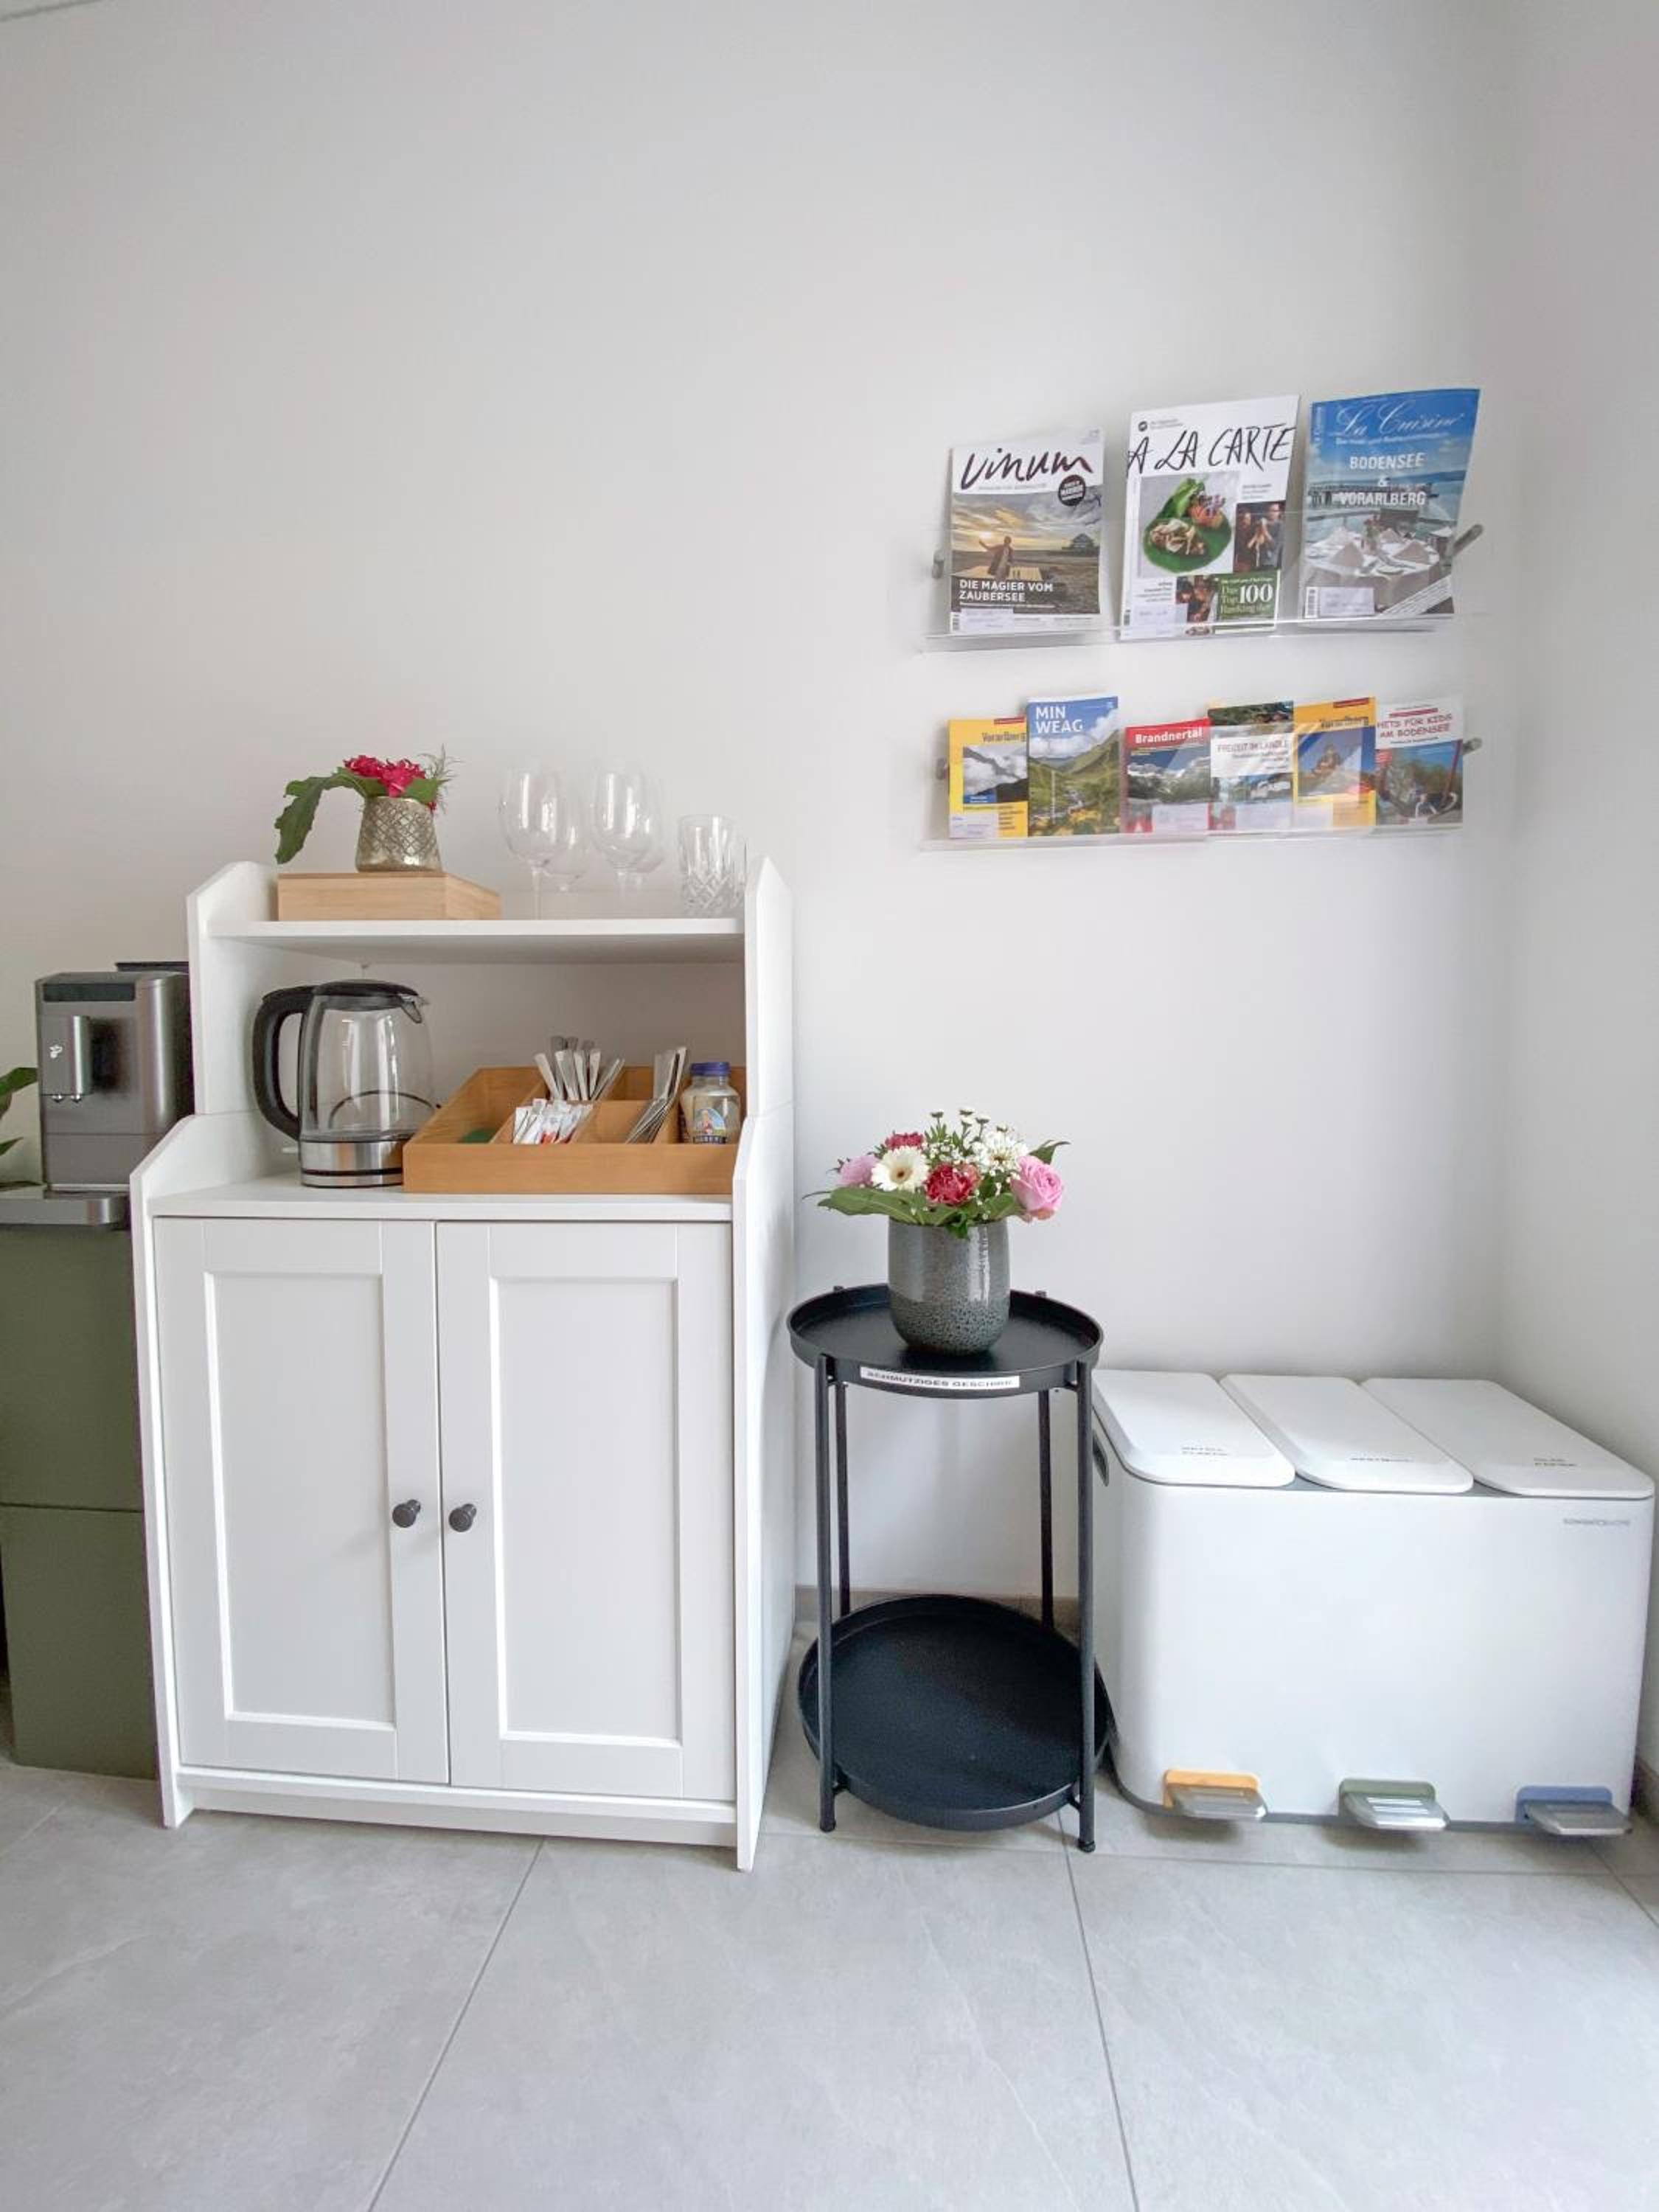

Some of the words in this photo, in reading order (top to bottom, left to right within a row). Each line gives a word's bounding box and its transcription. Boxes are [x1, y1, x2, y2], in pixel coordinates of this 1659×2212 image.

[1127, 437, 1152, 476] A
[1154, 430, 1200, 471] LA
[1208, 422, 1296, 473] CARTE
[1349, 452, 1427, 470] BODENSEE
[1339, 491, 1427, 506] VORARLBERG
[959, 580, 980, 590] DIE
[981, 581, 1026, 591] MAGIER
[1028, 582, 1054, 592] VOM
[959, 591, 1026, 602] ZAUBERSEE
[1239, 584, 1273, 604] 100
[1035, 706, 1065, 720] MIN
[1035, 719, 1083, 734] WEAG
[1377, 720, 1402, 729] HITS
[1405, 717, 1424, 726] FÜR
[1427, 714, 1453, 724] KIDS
[1135, 726, 1203, 744] Brandnertal
[1397, 723, 1450, 737] BODENSEE
[866, 1371, 949, 1387] SCHMUTZIGES
